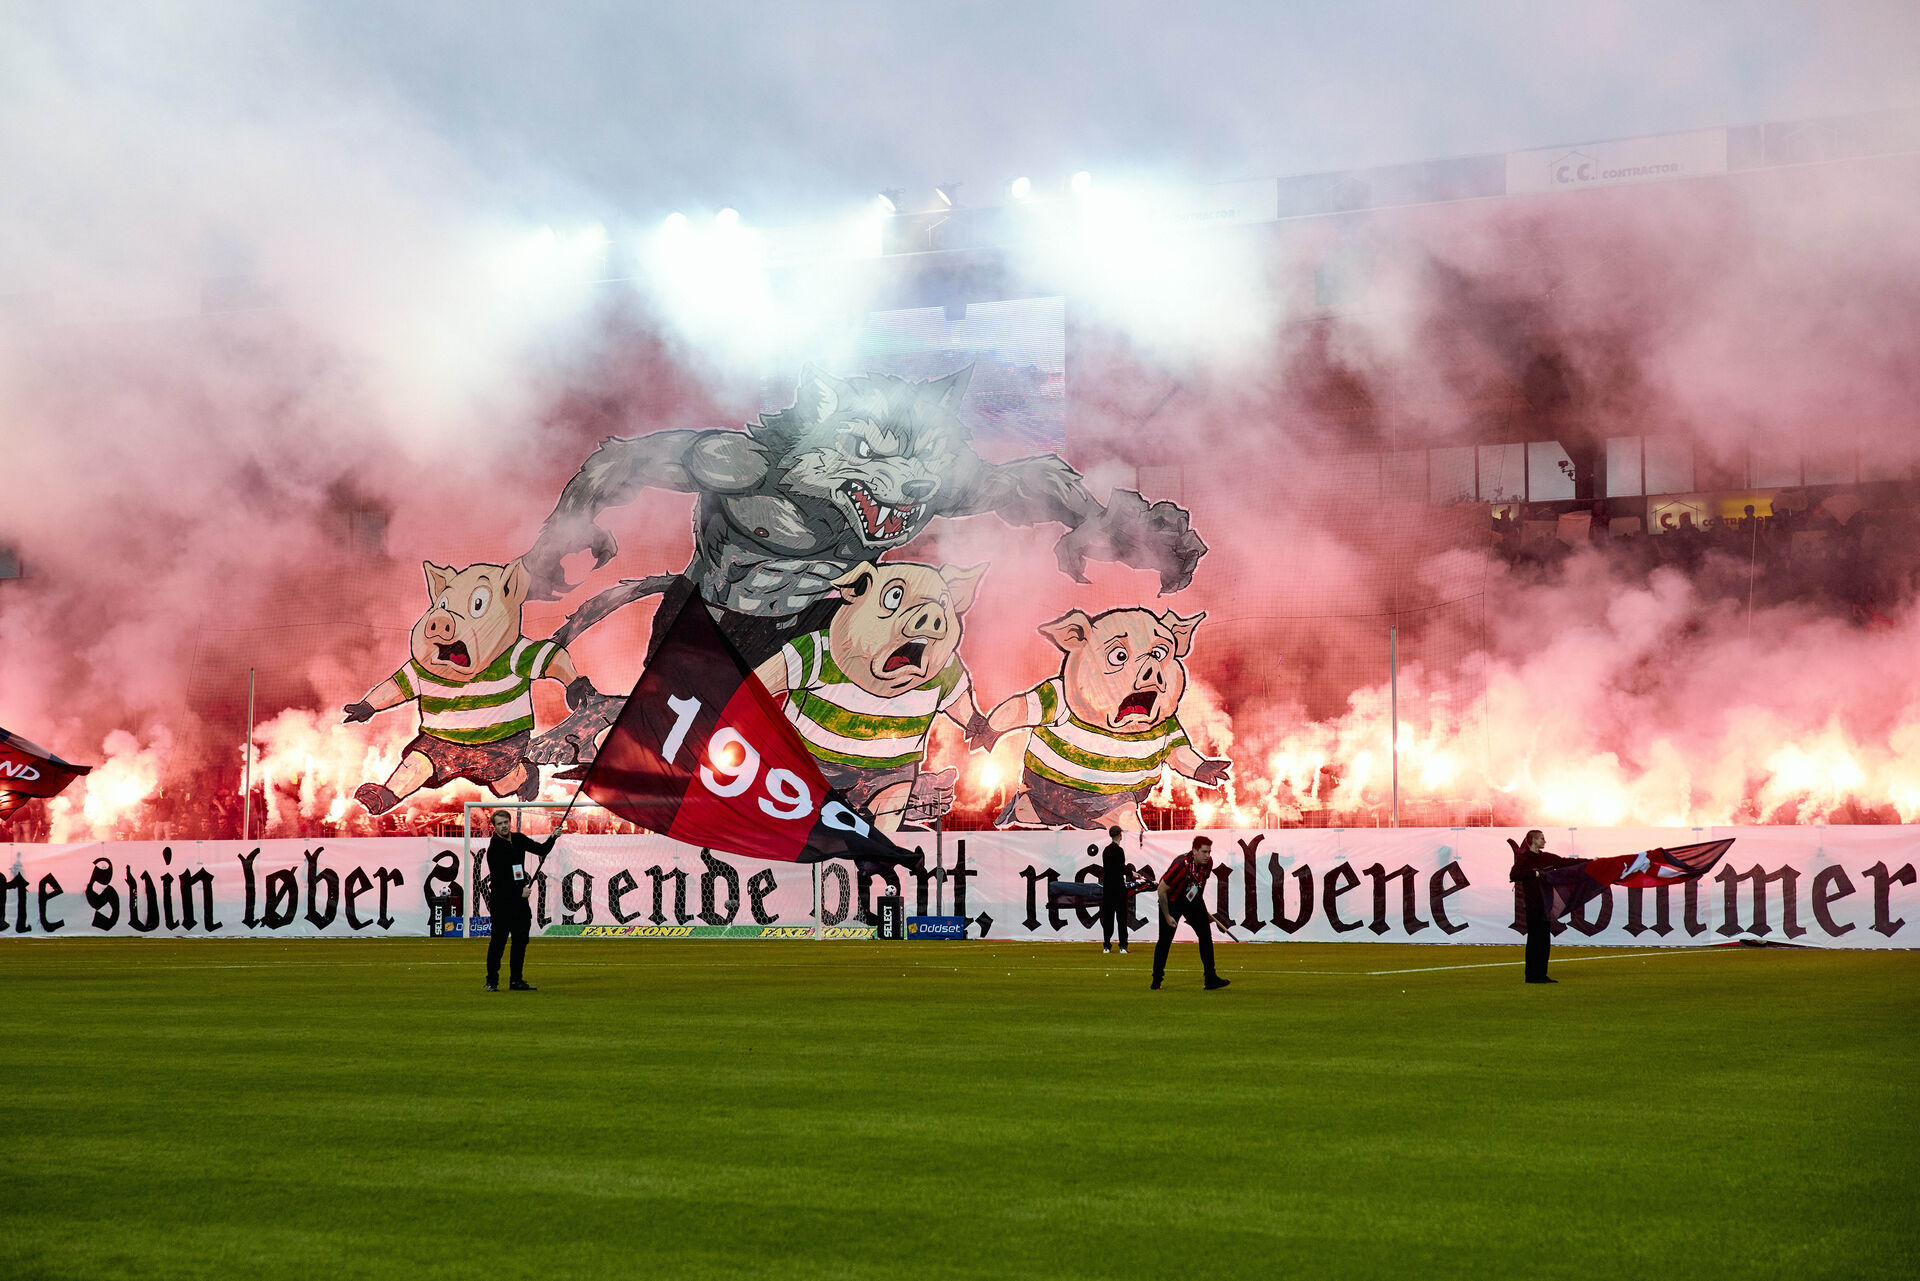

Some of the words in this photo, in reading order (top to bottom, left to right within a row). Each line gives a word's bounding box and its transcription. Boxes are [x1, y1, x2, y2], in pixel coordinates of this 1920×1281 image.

[1556, 163, 1595, 184] C.C.
[1602, 163, 1679, 179] CONTRACTOR
[85, 846, 223, 932] svin
[237, 846, 405, 930] løber
[434, 905, 443, 936] SELECT
[883, 905, 893, 938] SELECT
[920, 923, 961, 933] Oddset
[579, 926, 629, 937] FAXE
[629, 926, 696, 937] KONDI
[759, 927, 811, 938] FAXE
